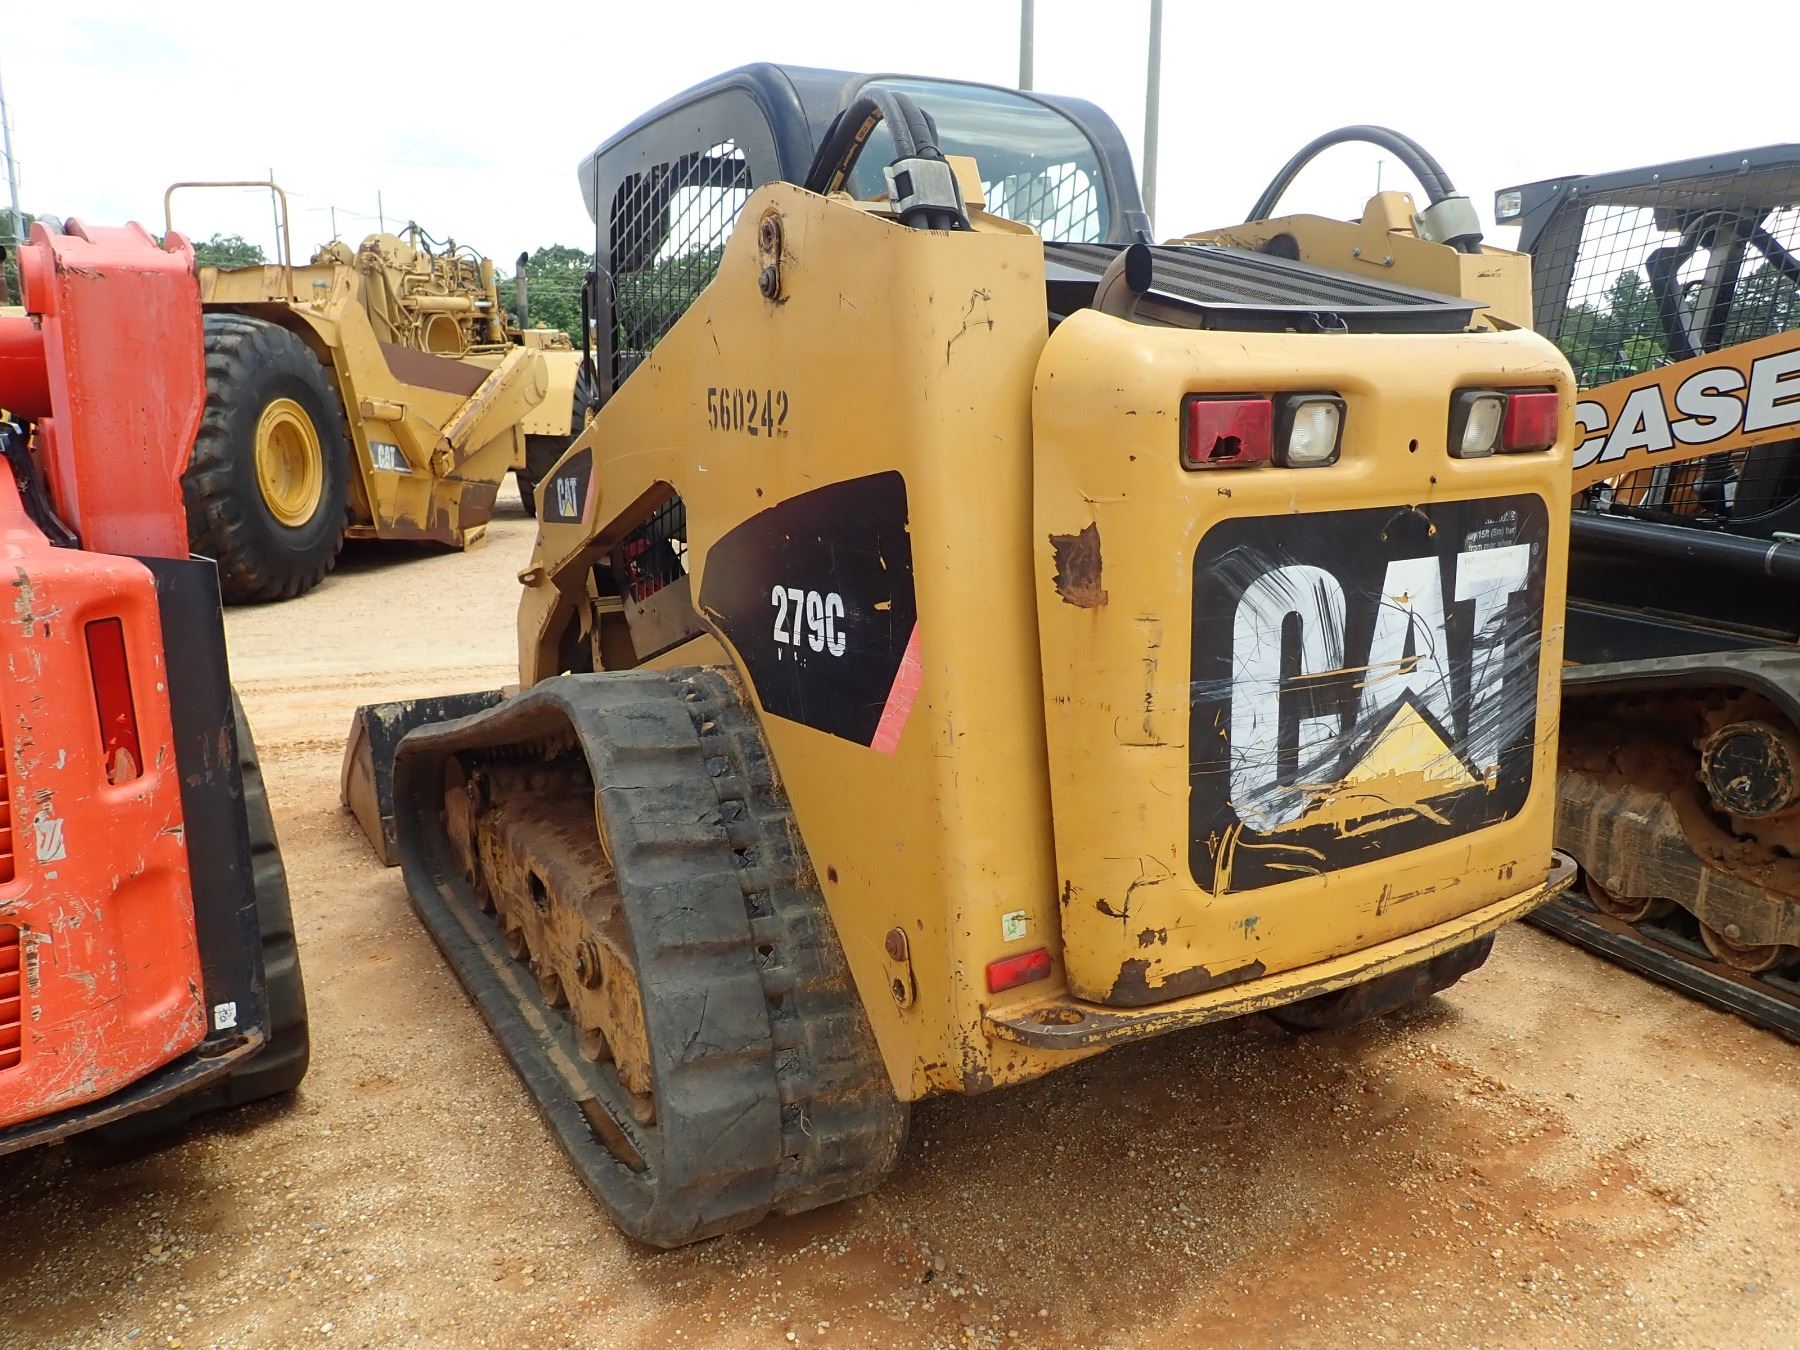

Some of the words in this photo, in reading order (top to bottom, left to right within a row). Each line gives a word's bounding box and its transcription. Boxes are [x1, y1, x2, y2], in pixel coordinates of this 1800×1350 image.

[707, 387, 789, 438] 560242
[1573, 348, 1800, 470] CASE
[378, 444, 396, 469] CAT
[556, 477, 577, 517] CAT
[771, 584, 846, 657] 279C
[1230, 543, 1531, 836] CAT
